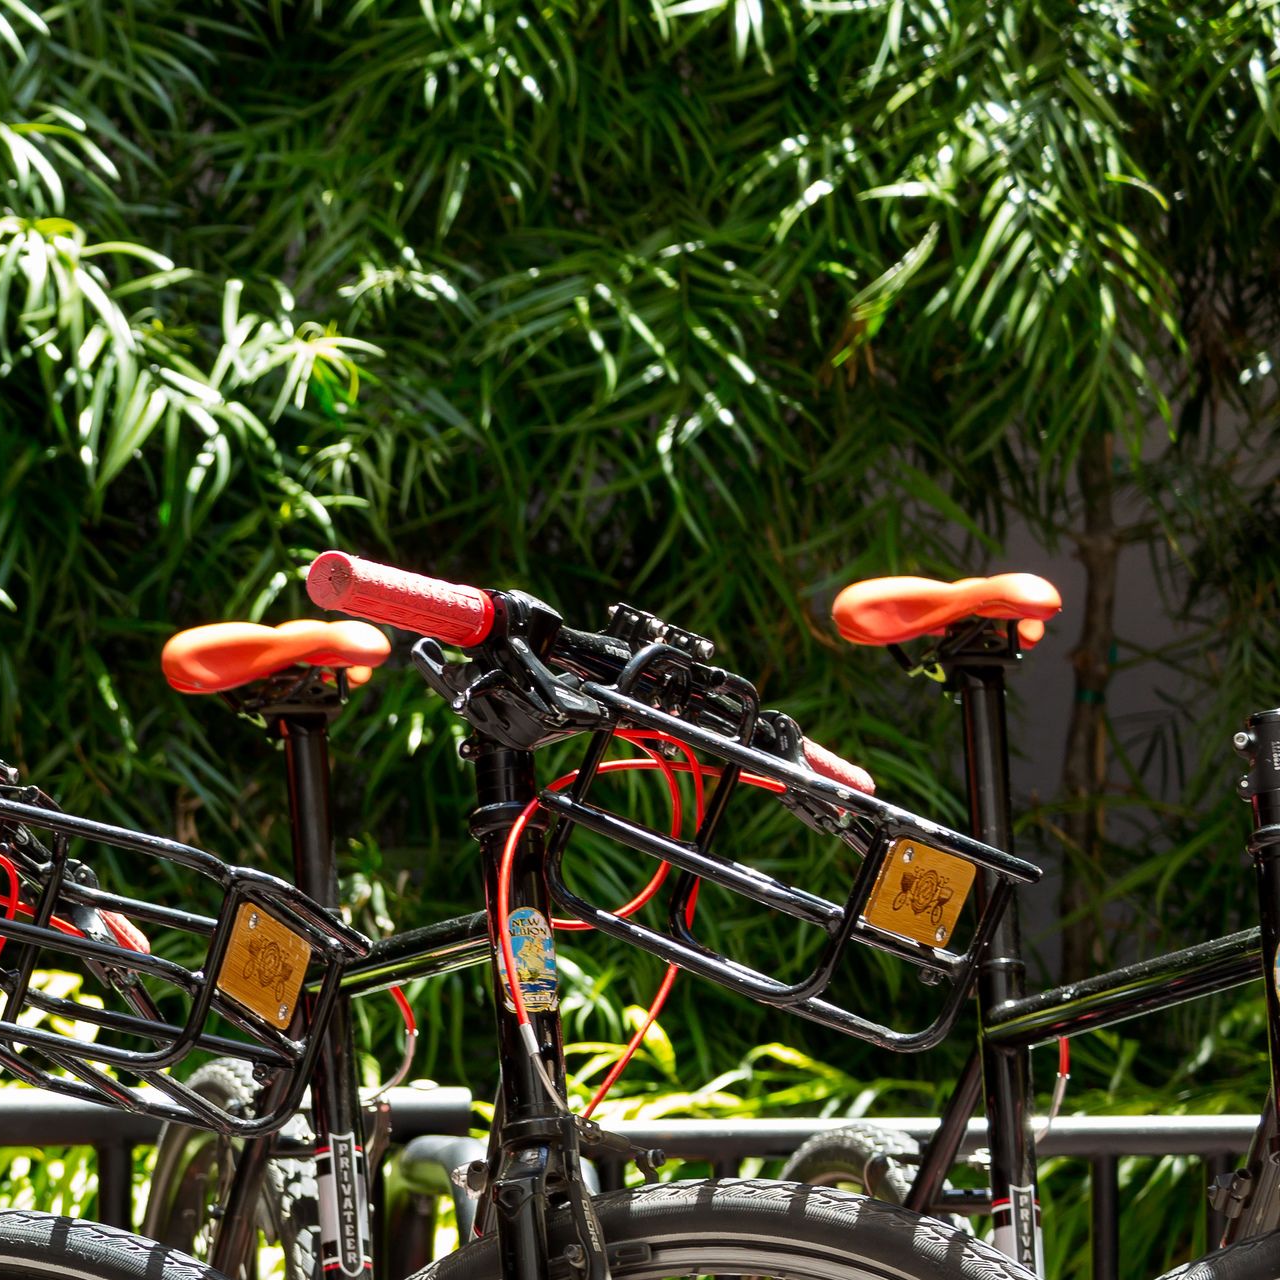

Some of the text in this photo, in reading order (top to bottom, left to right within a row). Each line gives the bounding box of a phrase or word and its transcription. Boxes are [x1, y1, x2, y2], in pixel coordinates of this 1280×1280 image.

[512, 918, 540, 927] NEW
[338, 1142, 358, 1265] PRIVATEER
[581, 1199, 602, 1253] DEORE
